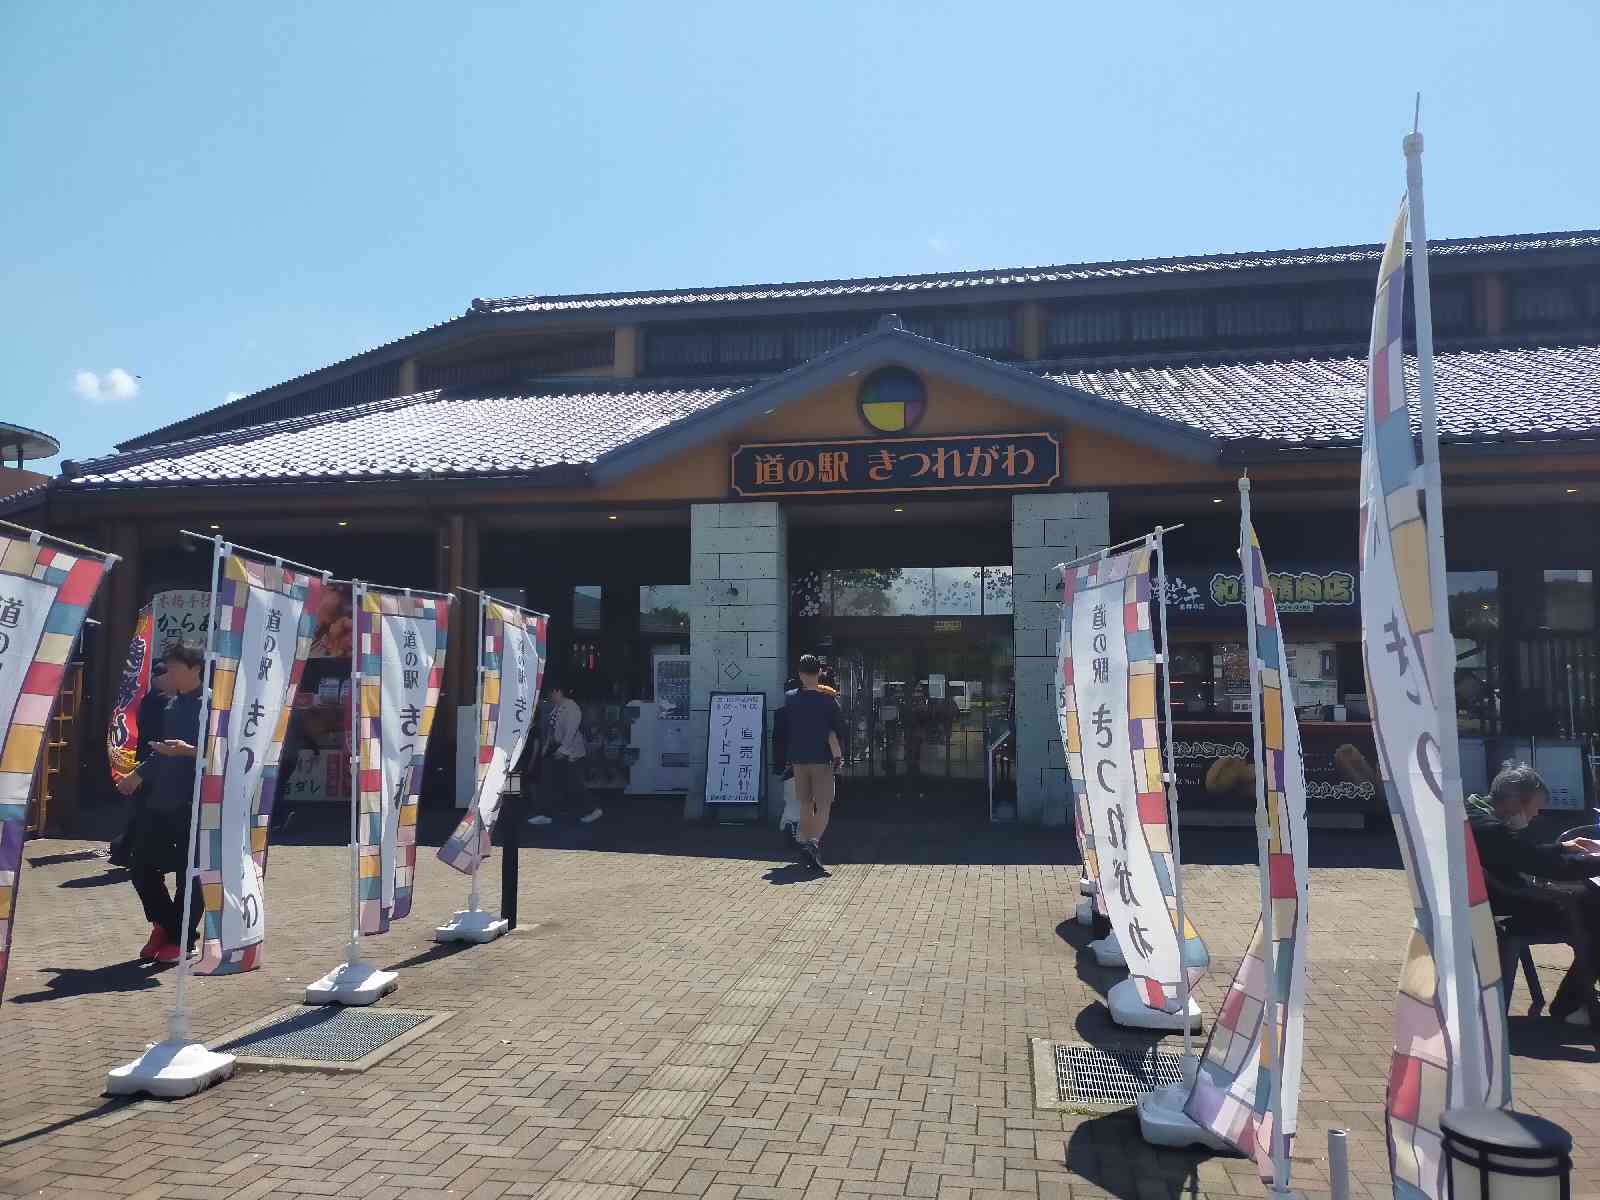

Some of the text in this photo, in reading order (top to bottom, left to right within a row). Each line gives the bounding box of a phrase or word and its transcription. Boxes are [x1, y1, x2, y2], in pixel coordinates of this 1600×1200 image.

[755, 444, 1035, 485] 道の駅 きつれがわ
[157, 613, 217, 632] からあ
[257, 608, 282, 682] 道の駅
[402, 630, 420, 690] 道の駅
[718, 714, 733, 792] フードコート
